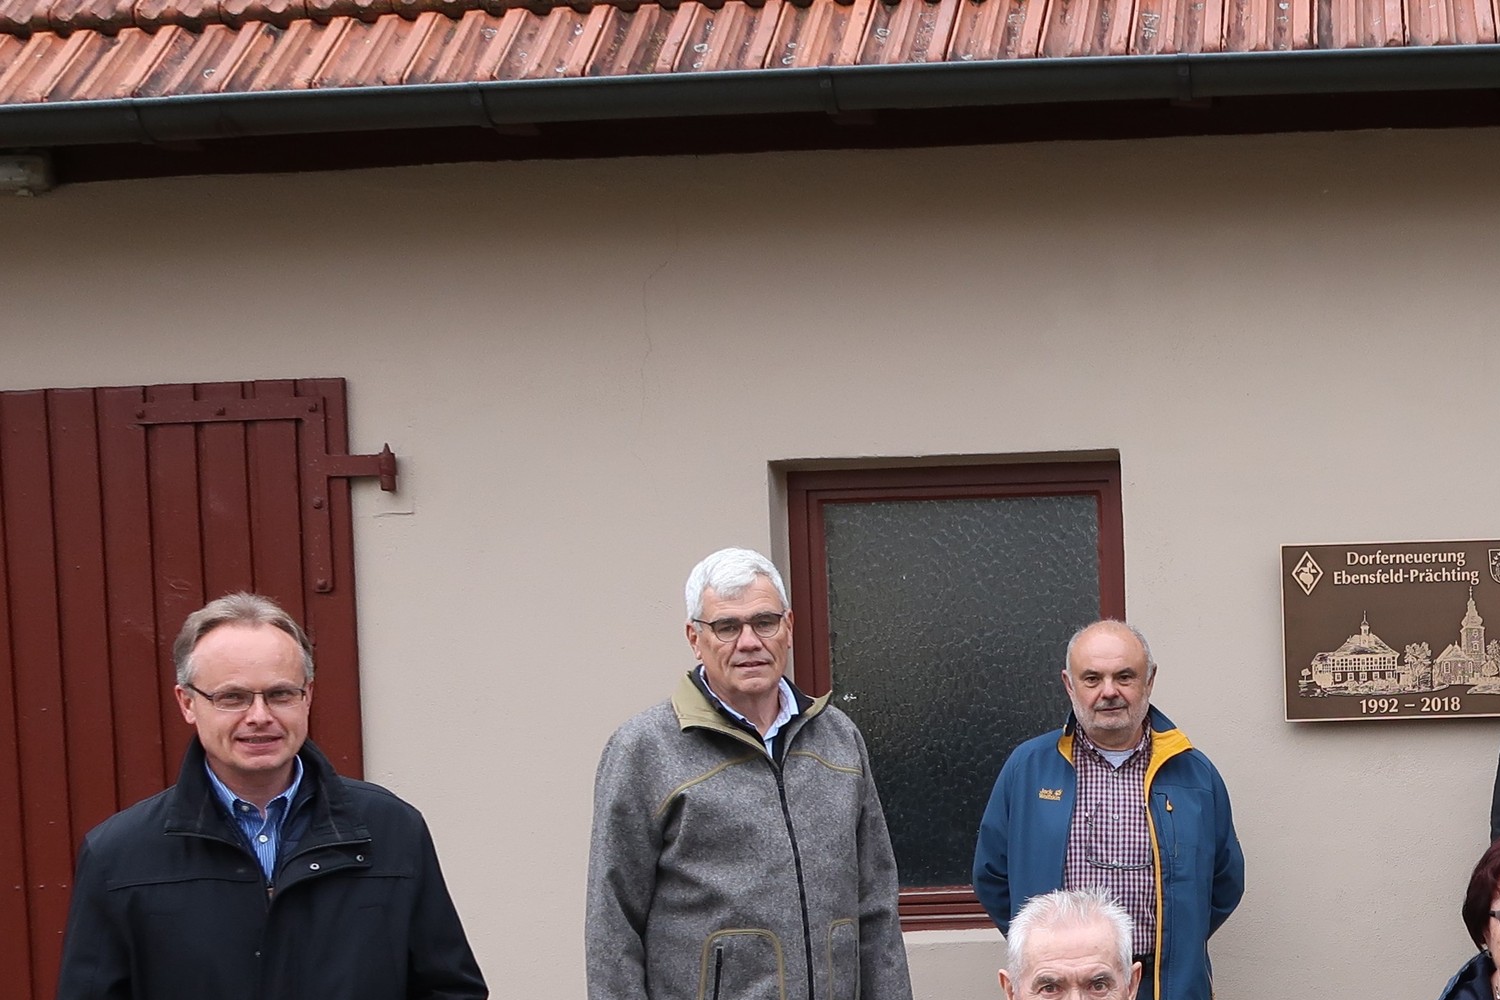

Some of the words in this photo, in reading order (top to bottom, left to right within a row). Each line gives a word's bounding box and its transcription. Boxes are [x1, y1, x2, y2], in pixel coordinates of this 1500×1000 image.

[1346, 550, 1466, 567] Dorferneuerung
[1333, 568, 1480, 586] Ebensfeld-Prächting
[1359, 697, 1399, 714] 1992
[1420, 696, 1461, 712] 2018
